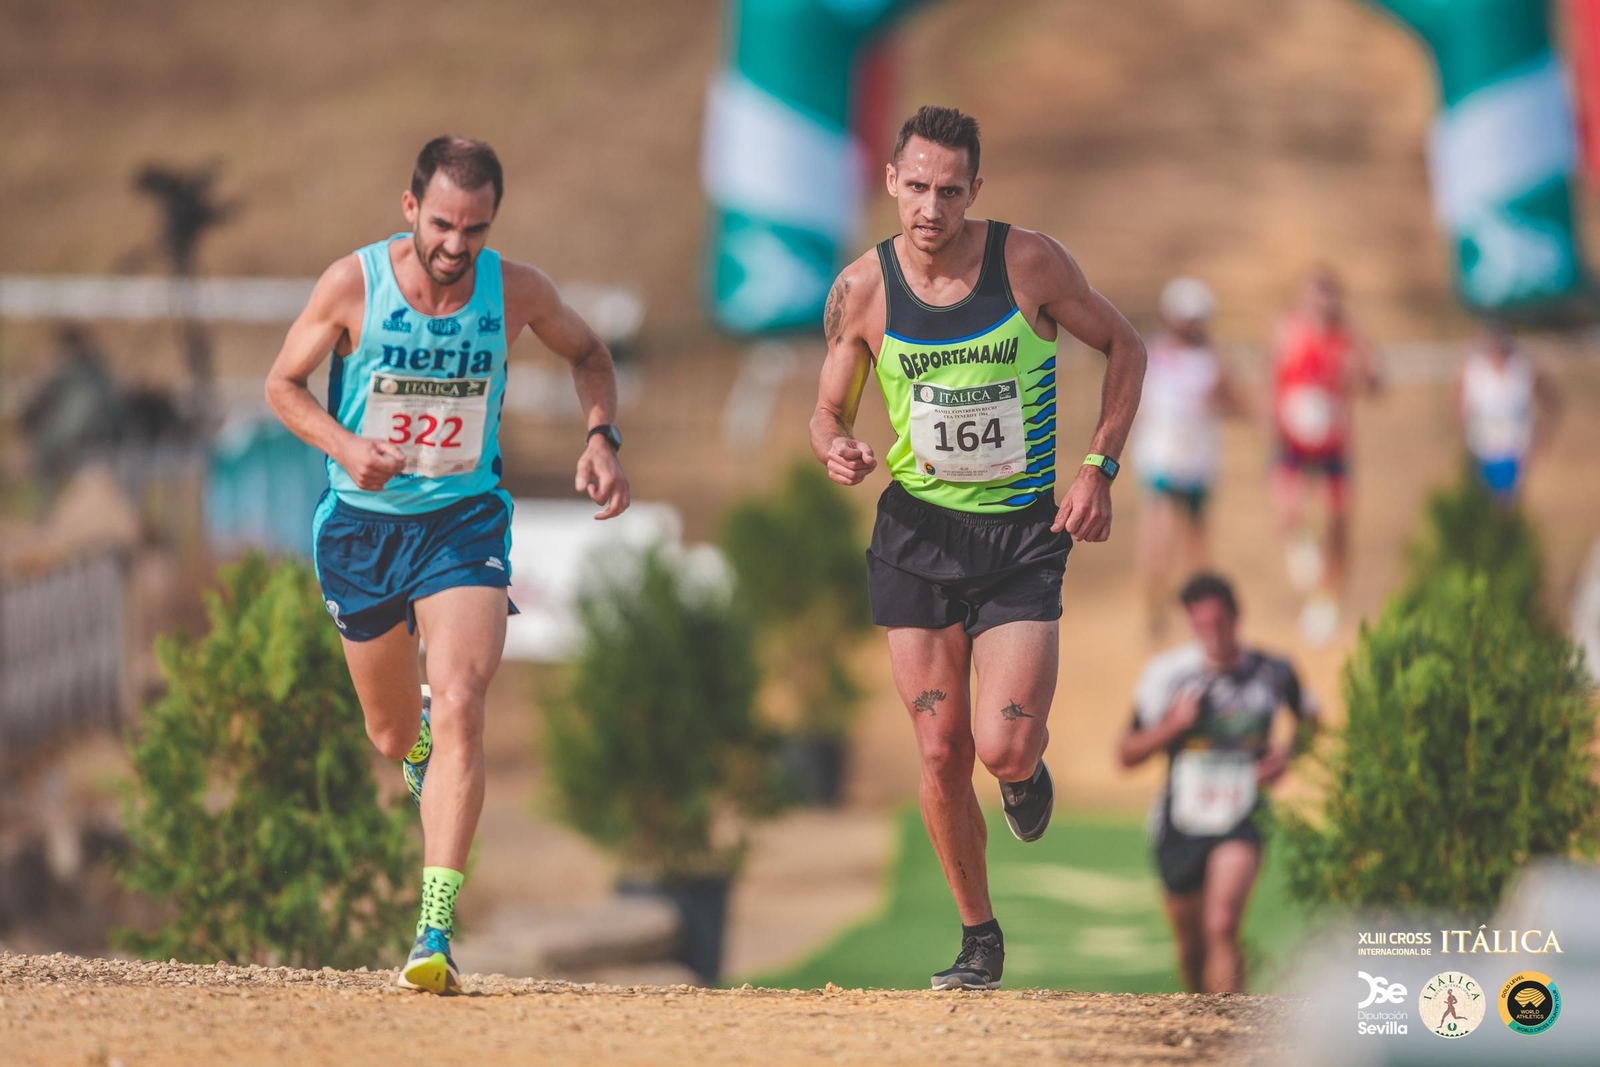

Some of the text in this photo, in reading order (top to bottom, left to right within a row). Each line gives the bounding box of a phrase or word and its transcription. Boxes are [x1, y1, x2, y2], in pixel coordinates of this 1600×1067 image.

[381, 341, 492, 378] nerja
[898, 336, 1019, 380] DEPORTEMANIA
[939, 390, 991, 404] ITÁLICA
[388, 413, 463, 448] 322
[933, 418, 1005, 452] 164
